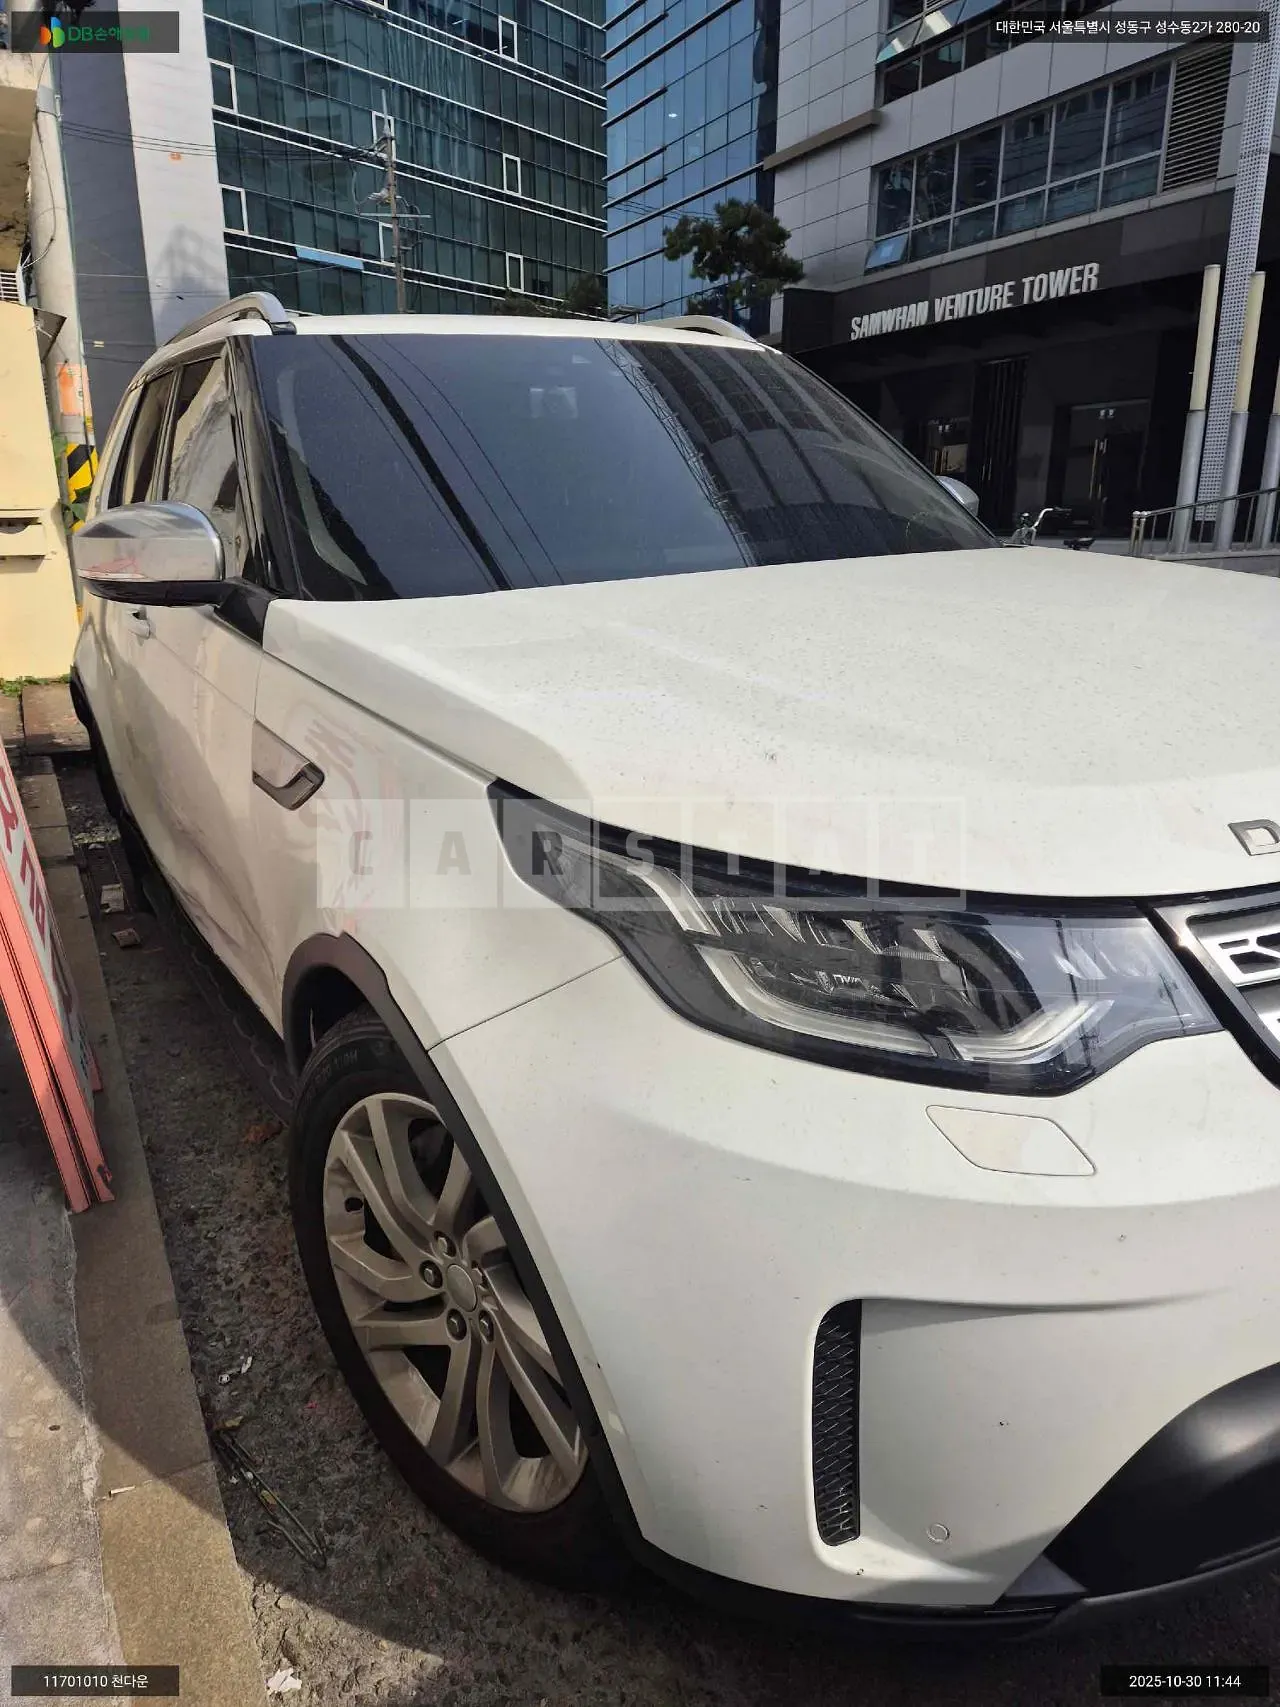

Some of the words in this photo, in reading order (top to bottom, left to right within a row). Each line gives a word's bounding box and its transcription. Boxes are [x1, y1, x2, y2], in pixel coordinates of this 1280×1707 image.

[850, 301, 929, 341] SAMWHAN
[934, 280, 1016, 322] VENTURE
[1021, 262, 1100, 305] TOWER
